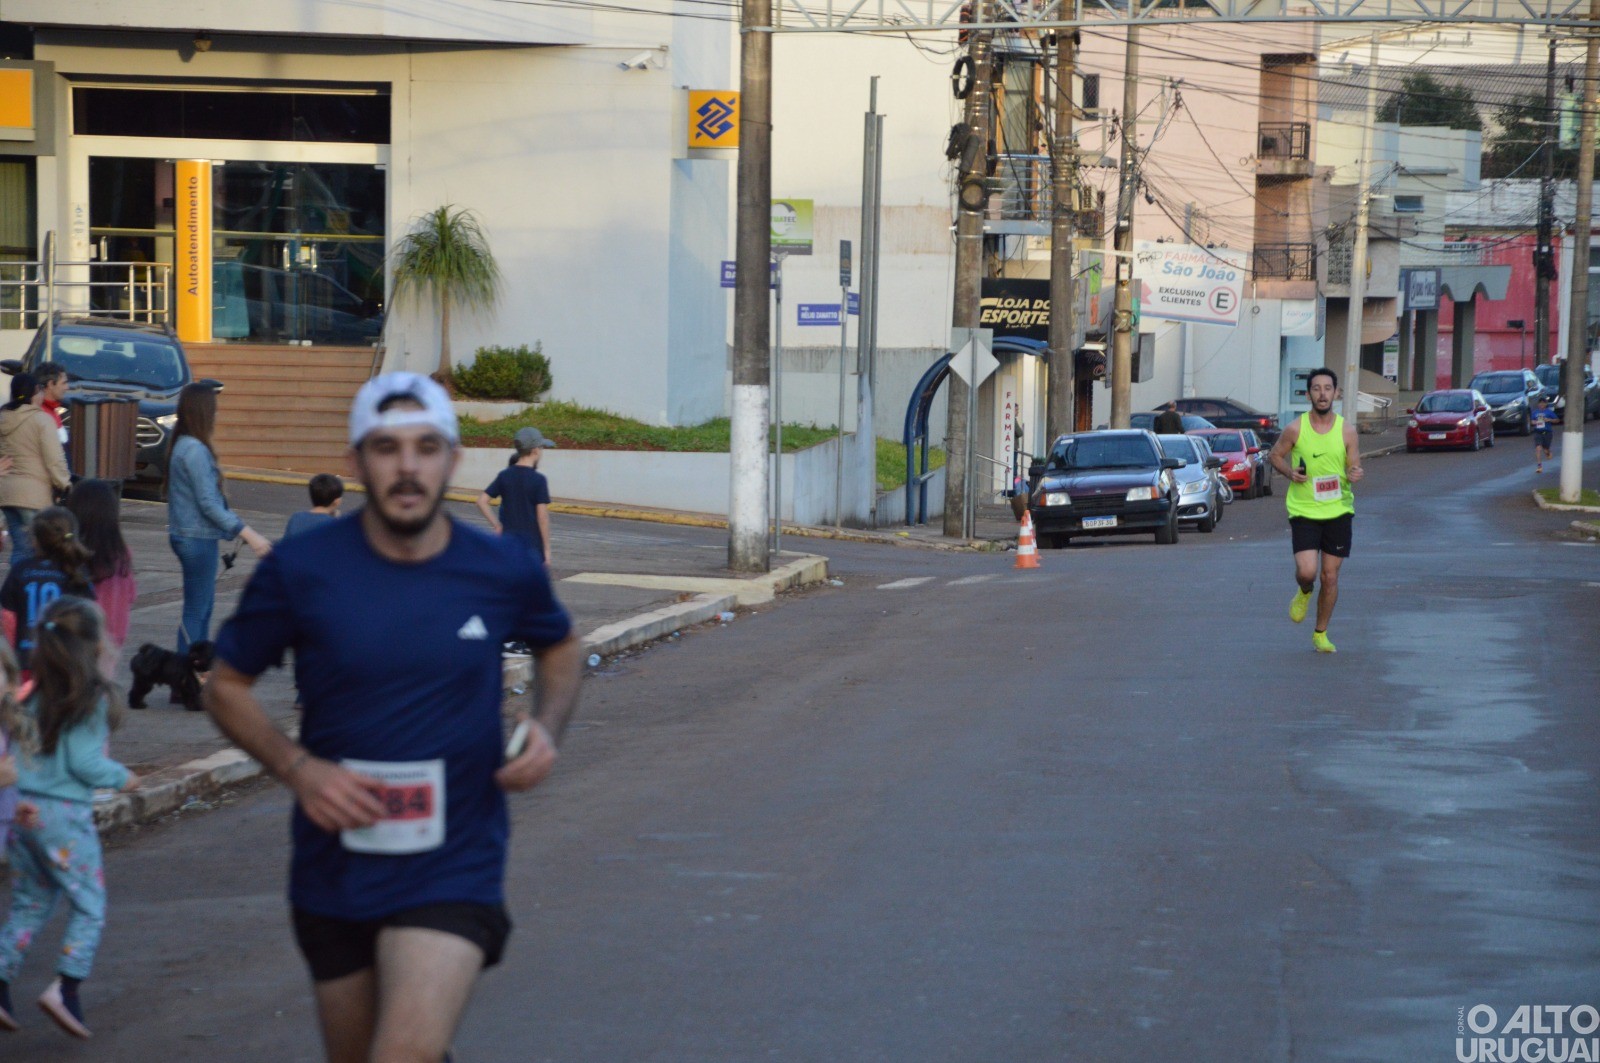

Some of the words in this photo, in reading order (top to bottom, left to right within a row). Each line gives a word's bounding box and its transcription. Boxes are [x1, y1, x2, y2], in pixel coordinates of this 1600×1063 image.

[188, 176, 198, 296] Autoatendimento
[1162, 260, 1193, 276] São
[1197, 264, 1236, 281] João
[1159, 286, 1206, 298] EXCLUSIVO
[996, 298, 1030, 309] LOJA
[1161, 296, 1202, 306] CLIENTES
[1216, 292, 1230, 309] E
[980, 309, 1050, 325] ESPORTE
[1004, 391, 1013, 474] FARMÁCIA
